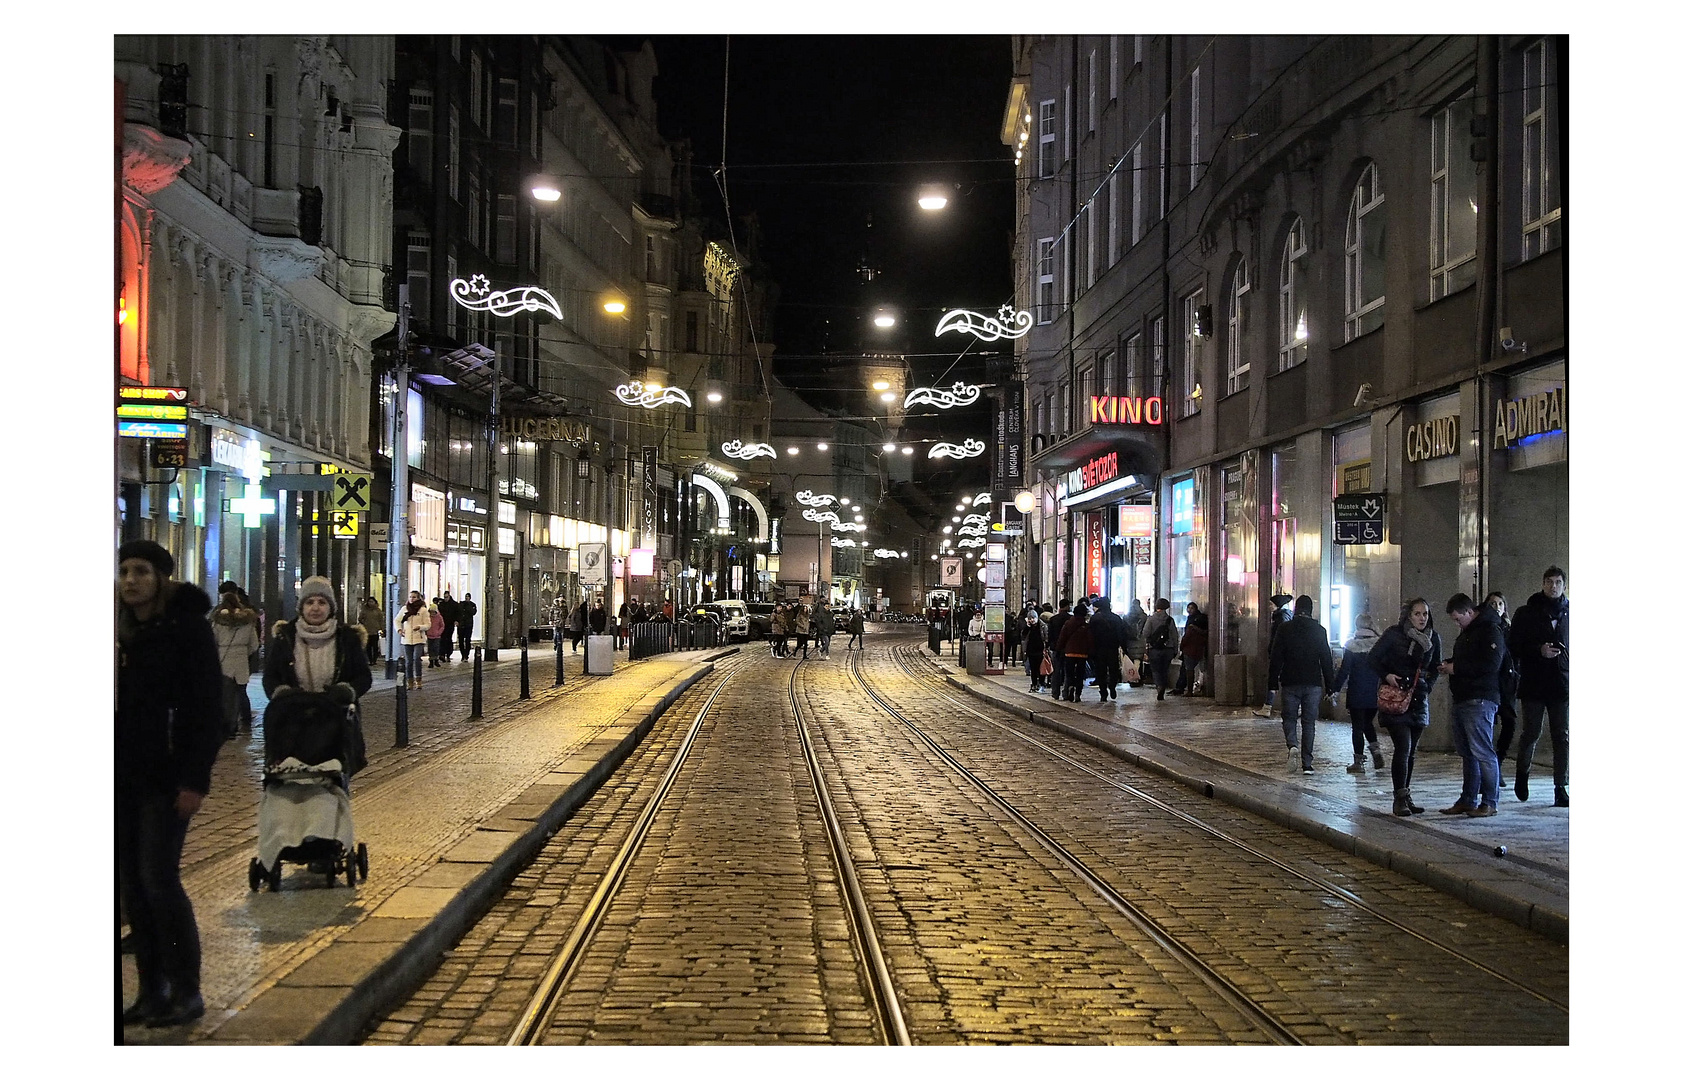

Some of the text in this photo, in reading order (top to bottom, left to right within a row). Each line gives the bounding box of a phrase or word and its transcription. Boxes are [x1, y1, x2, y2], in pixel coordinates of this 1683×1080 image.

[1091, 395, 1163, 425] KINO
[1407, 415, 1456, 462] CASINO
[1008, 444, 1019, 477] LANGHANS
[1068, 466, 1083, 494] KINO
[1082, 451, 1118, 489] SVĚTOZOR
